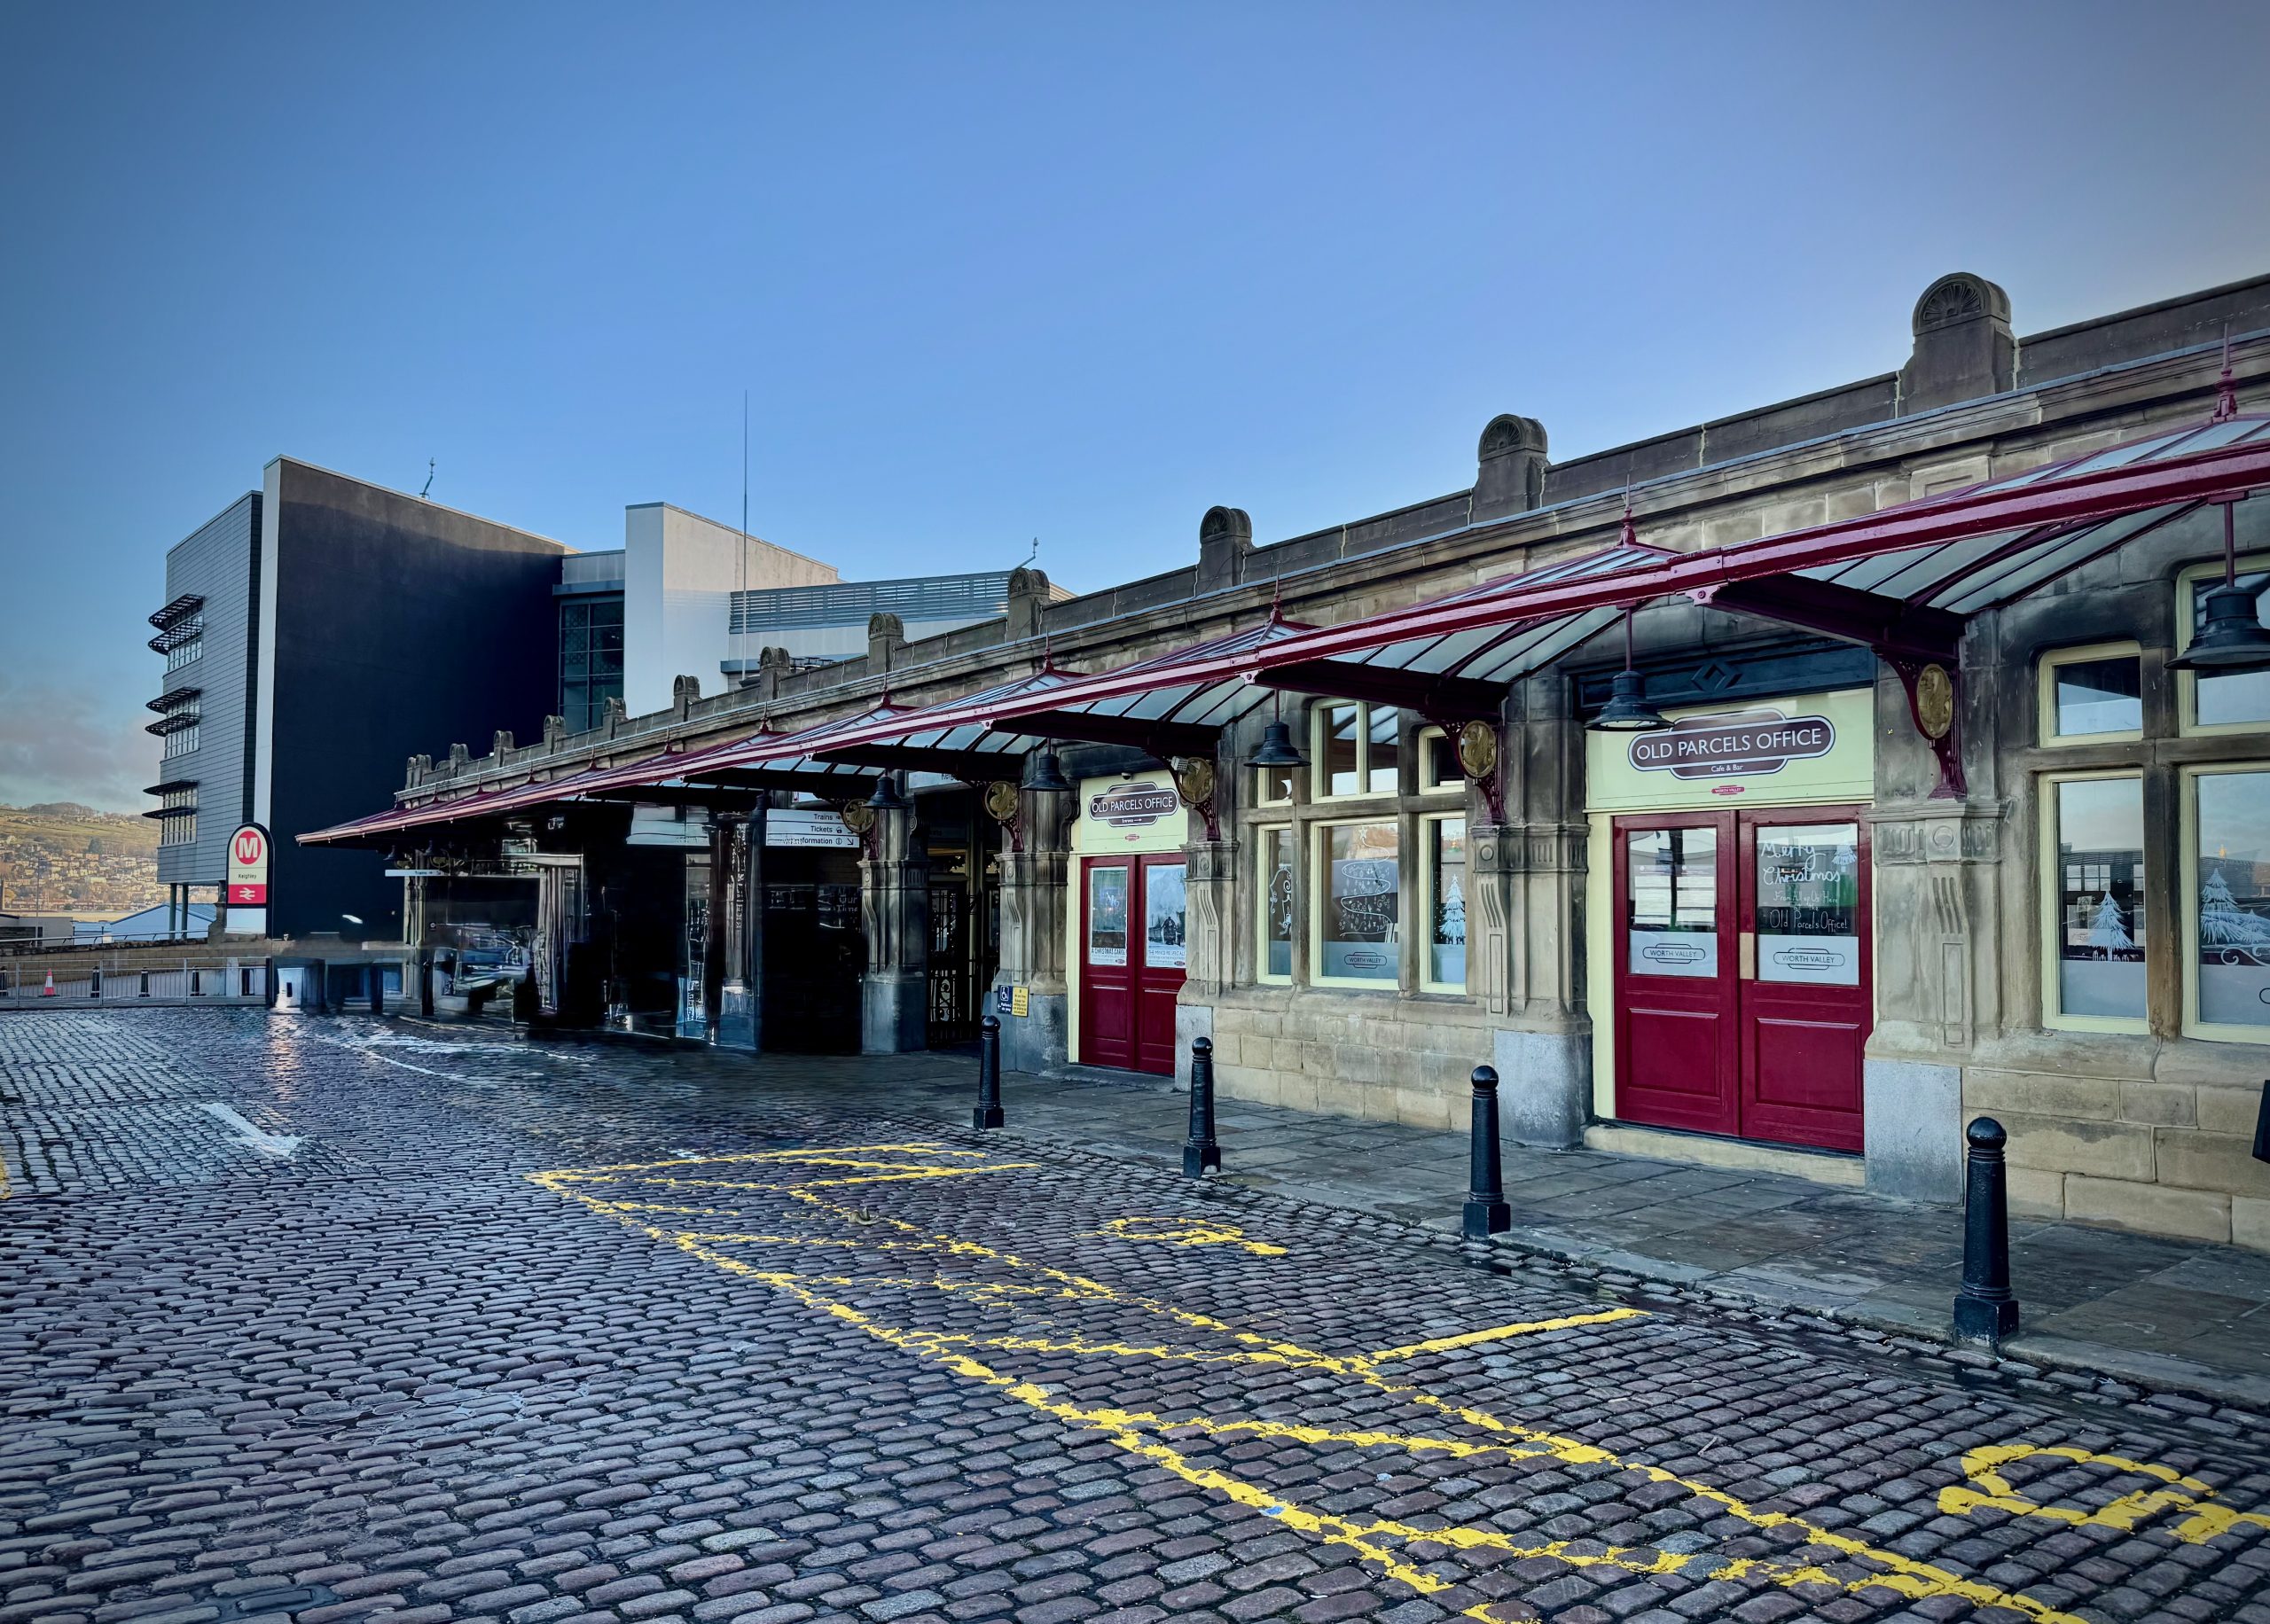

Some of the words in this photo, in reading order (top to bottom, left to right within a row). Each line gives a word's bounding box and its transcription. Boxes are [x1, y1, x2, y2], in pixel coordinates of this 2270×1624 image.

[1636, 742, 1673, 761] OLD
[1678, 735, 1750, 757] PARCELS
[1756, 728, 1822, 750] OFFICE
[1092, 801, 1108, 813] OLD
[1110, 799, 1143, 812] PARCELS
[1144, 796, 1173, 809] OFFICE
[239, 837, 258, 859] M
[1761, 842, 1827, 871] Merry
[1762, 865, 1841, 886] Christmas
[1770, 909, 1789, 928] Old
[1793, 910, 1820, 929] Parcels
